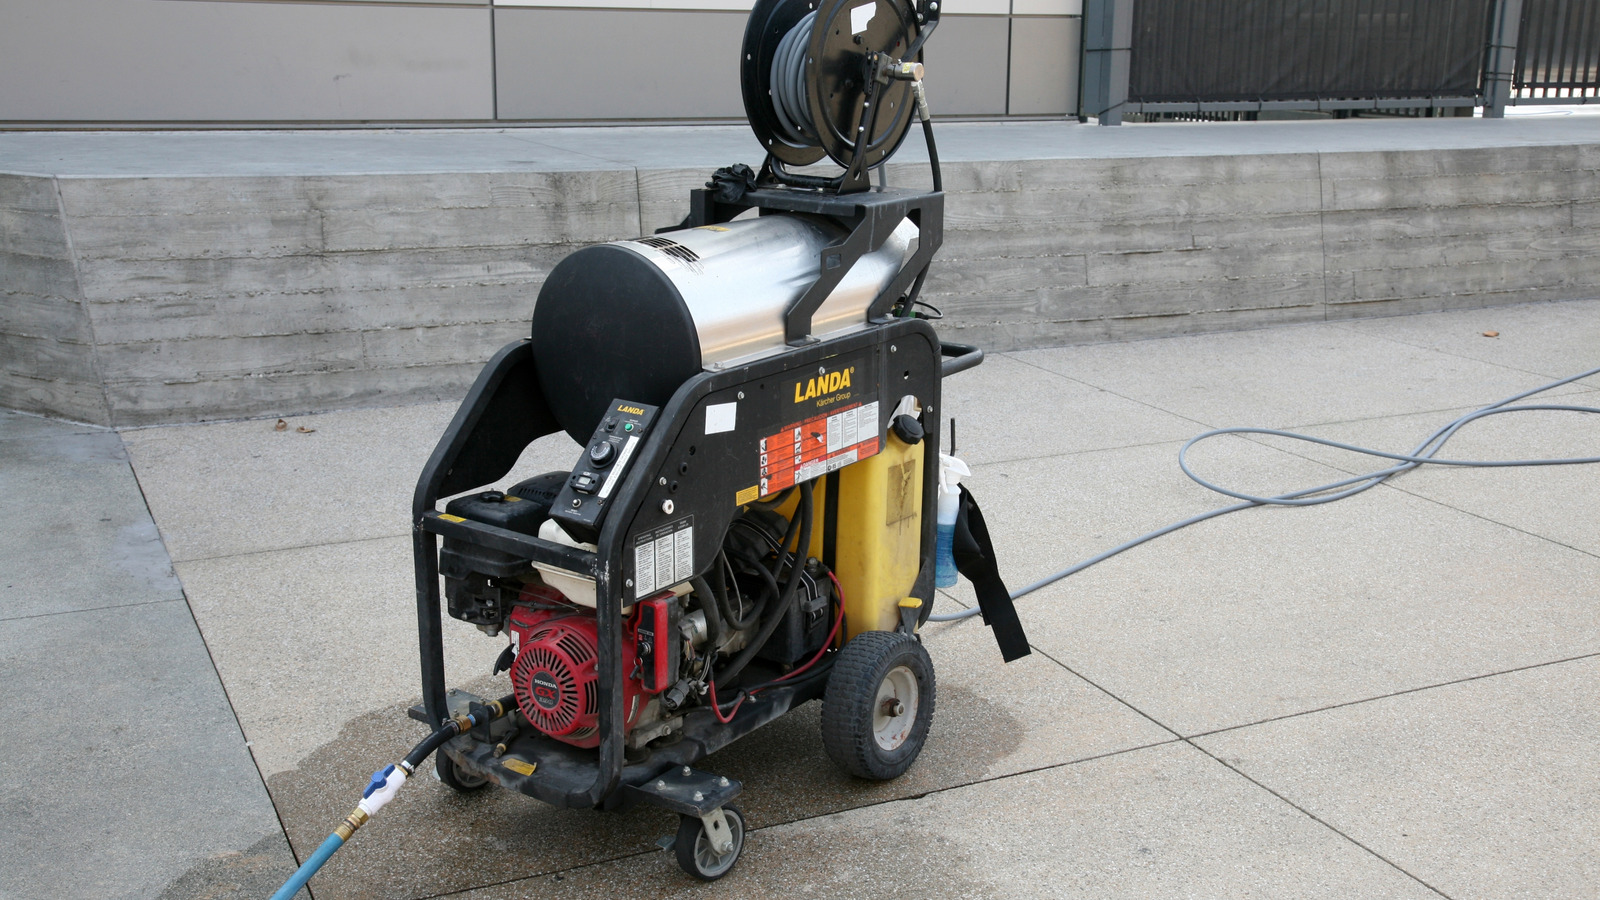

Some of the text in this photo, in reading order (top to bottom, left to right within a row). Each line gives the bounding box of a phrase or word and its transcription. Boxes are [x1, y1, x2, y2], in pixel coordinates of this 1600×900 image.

[816, 392, 851, 408] Kärcher Group
[617, 404, 645, 416] LANDA
[534, 679, 557, 689] HONDA
[535, 686, 557, 700] GX
